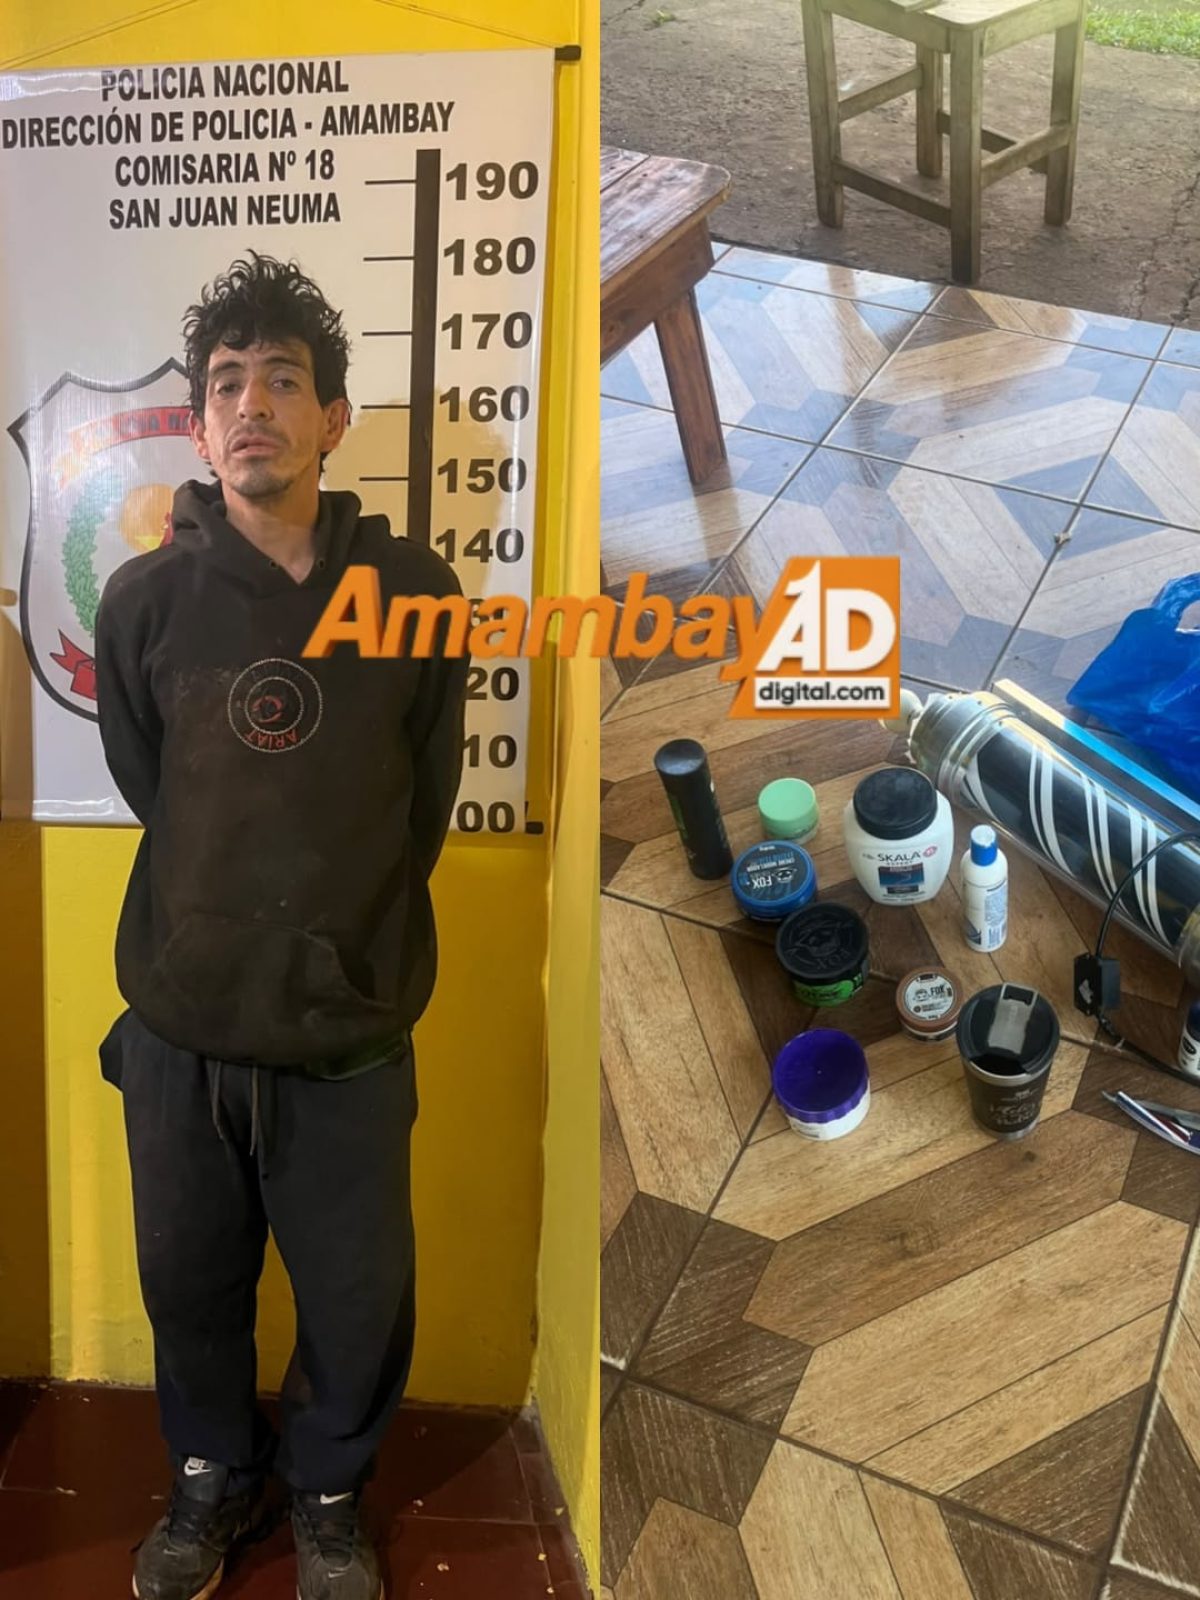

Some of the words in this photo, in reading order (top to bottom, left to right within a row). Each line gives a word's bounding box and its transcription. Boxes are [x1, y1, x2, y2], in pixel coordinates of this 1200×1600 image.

[101, 66, 205, 101] POLICIA
[213, 60, 349, 97] NACIONAL
[2, 106, 141, 148] DIRECCIÓN
[151, 111, 183, 142] DE
[193, 108, 297, 141] POLICIA
[304, 121, 312, 130] -
[320, 101, 455, 136] AMAMBAY
[115, 152, 260, 187] COMISARIA
[305, 149, 334, 181] 18
[446, 161, 539, 200] 190
[109, 198, 160, 229] SAN
[169, 196, 237, 227] JUAN
[247, 192, 341, 225] NEUMA
[443, 236, 536, 276] 180
[441, 311, 533, 350] 170
[439, 385, 530, 423] 160
[437, 458, 527, 494] 150
[435, 528, 524, 564] 140
[466, 667, 519, 701] 20
[244, 728, 298, 750] ARIAT
[877, 850, 921, 862] SKALA
[752, 875, 772, 890] FOX
